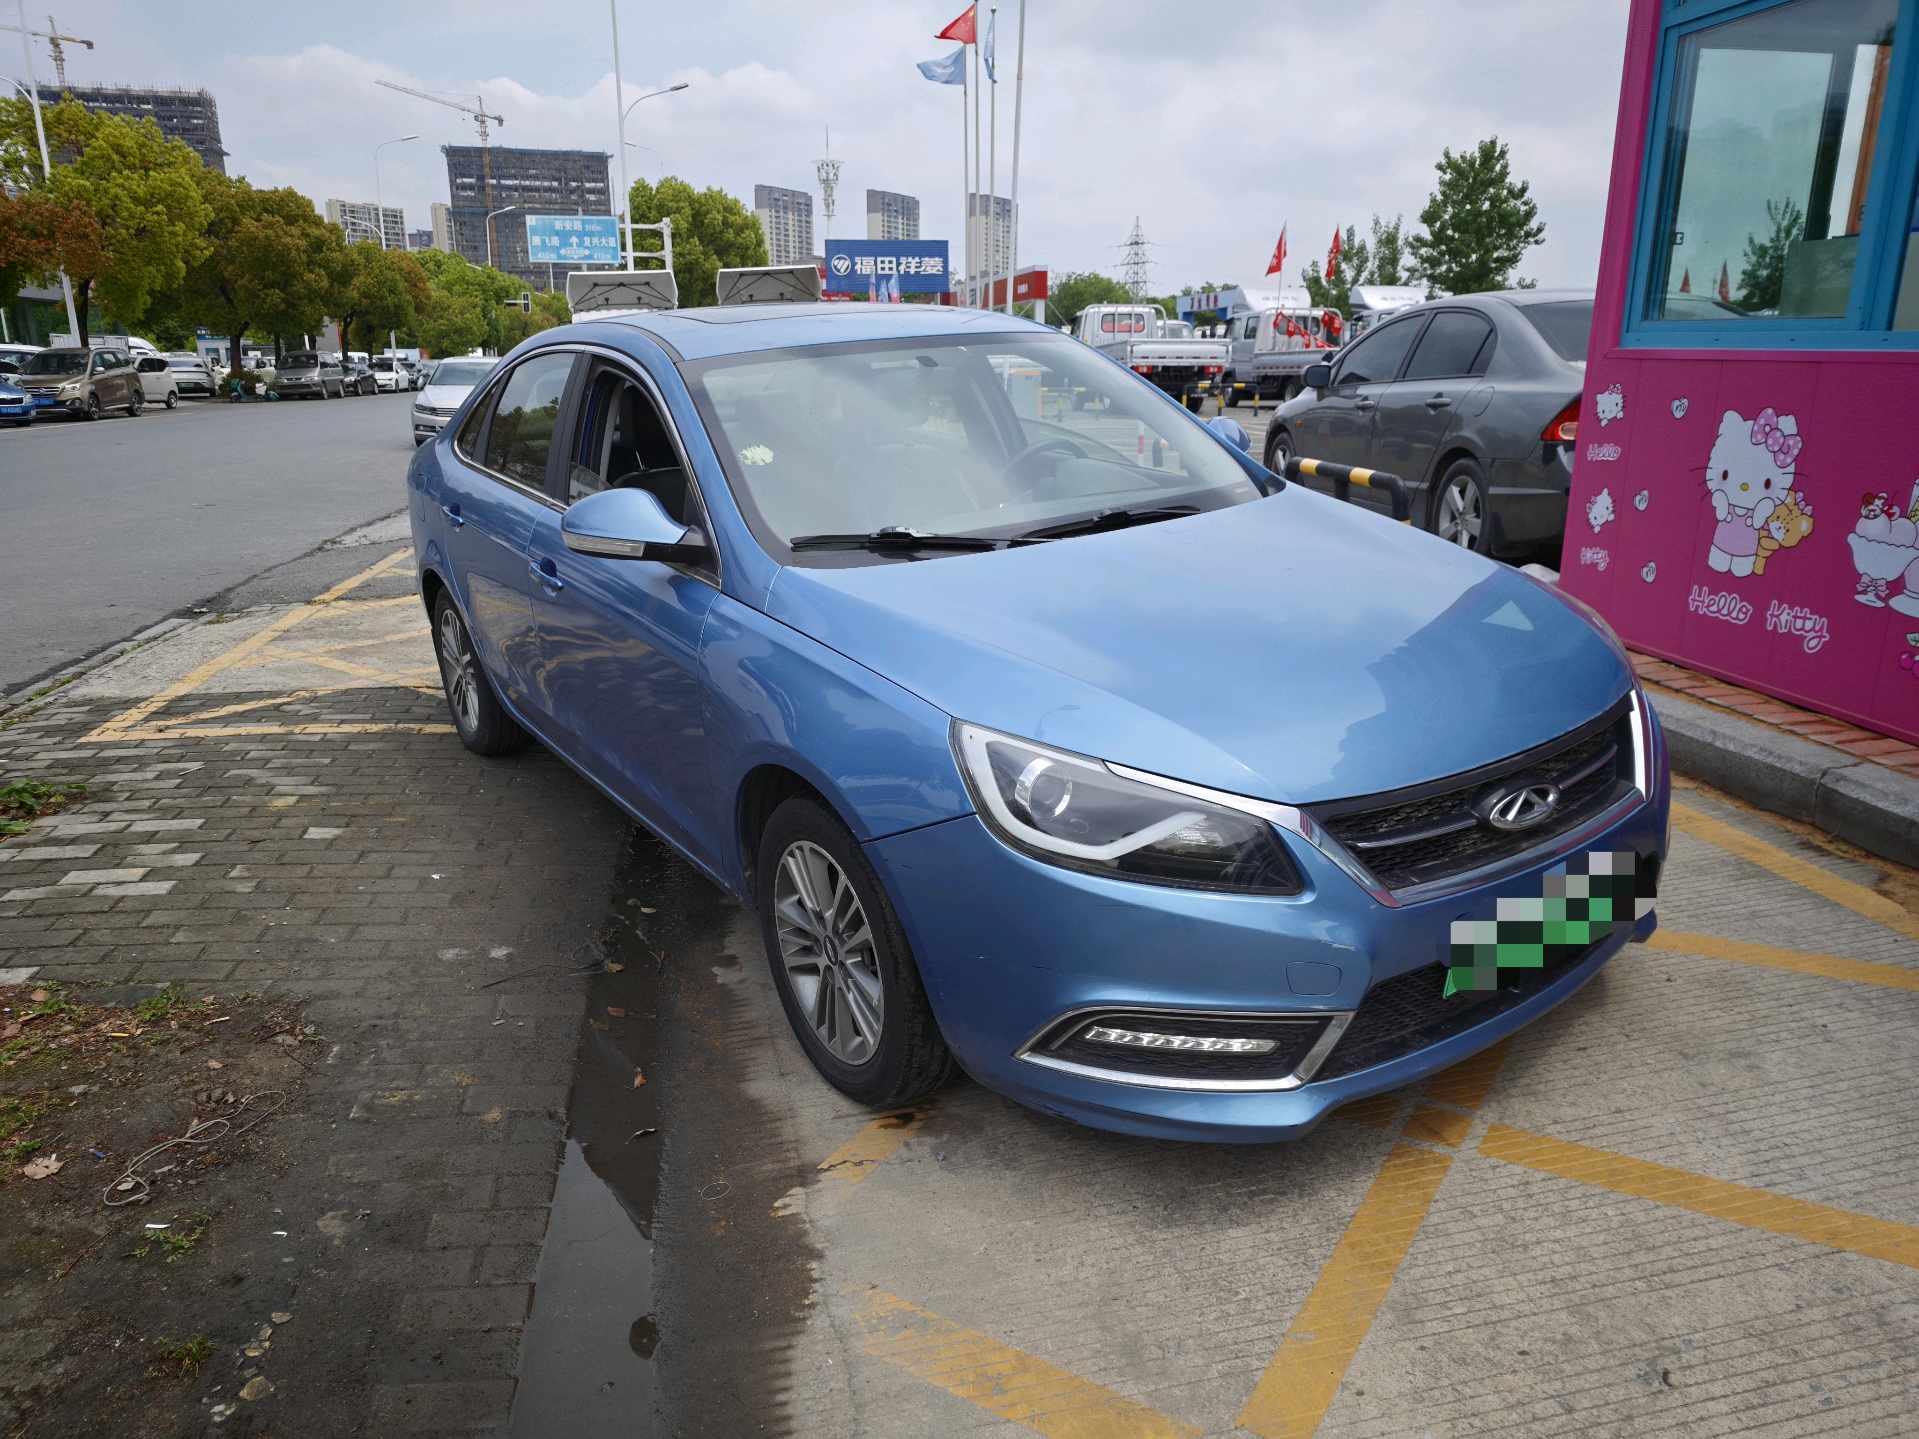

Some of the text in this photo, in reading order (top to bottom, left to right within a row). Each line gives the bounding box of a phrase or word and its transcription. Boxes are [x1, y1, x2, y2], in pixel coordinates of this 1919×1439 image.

[854, 256, 945, 275] 福田祥菱
[1688, 584, 1830, 654] Hello Kitty
